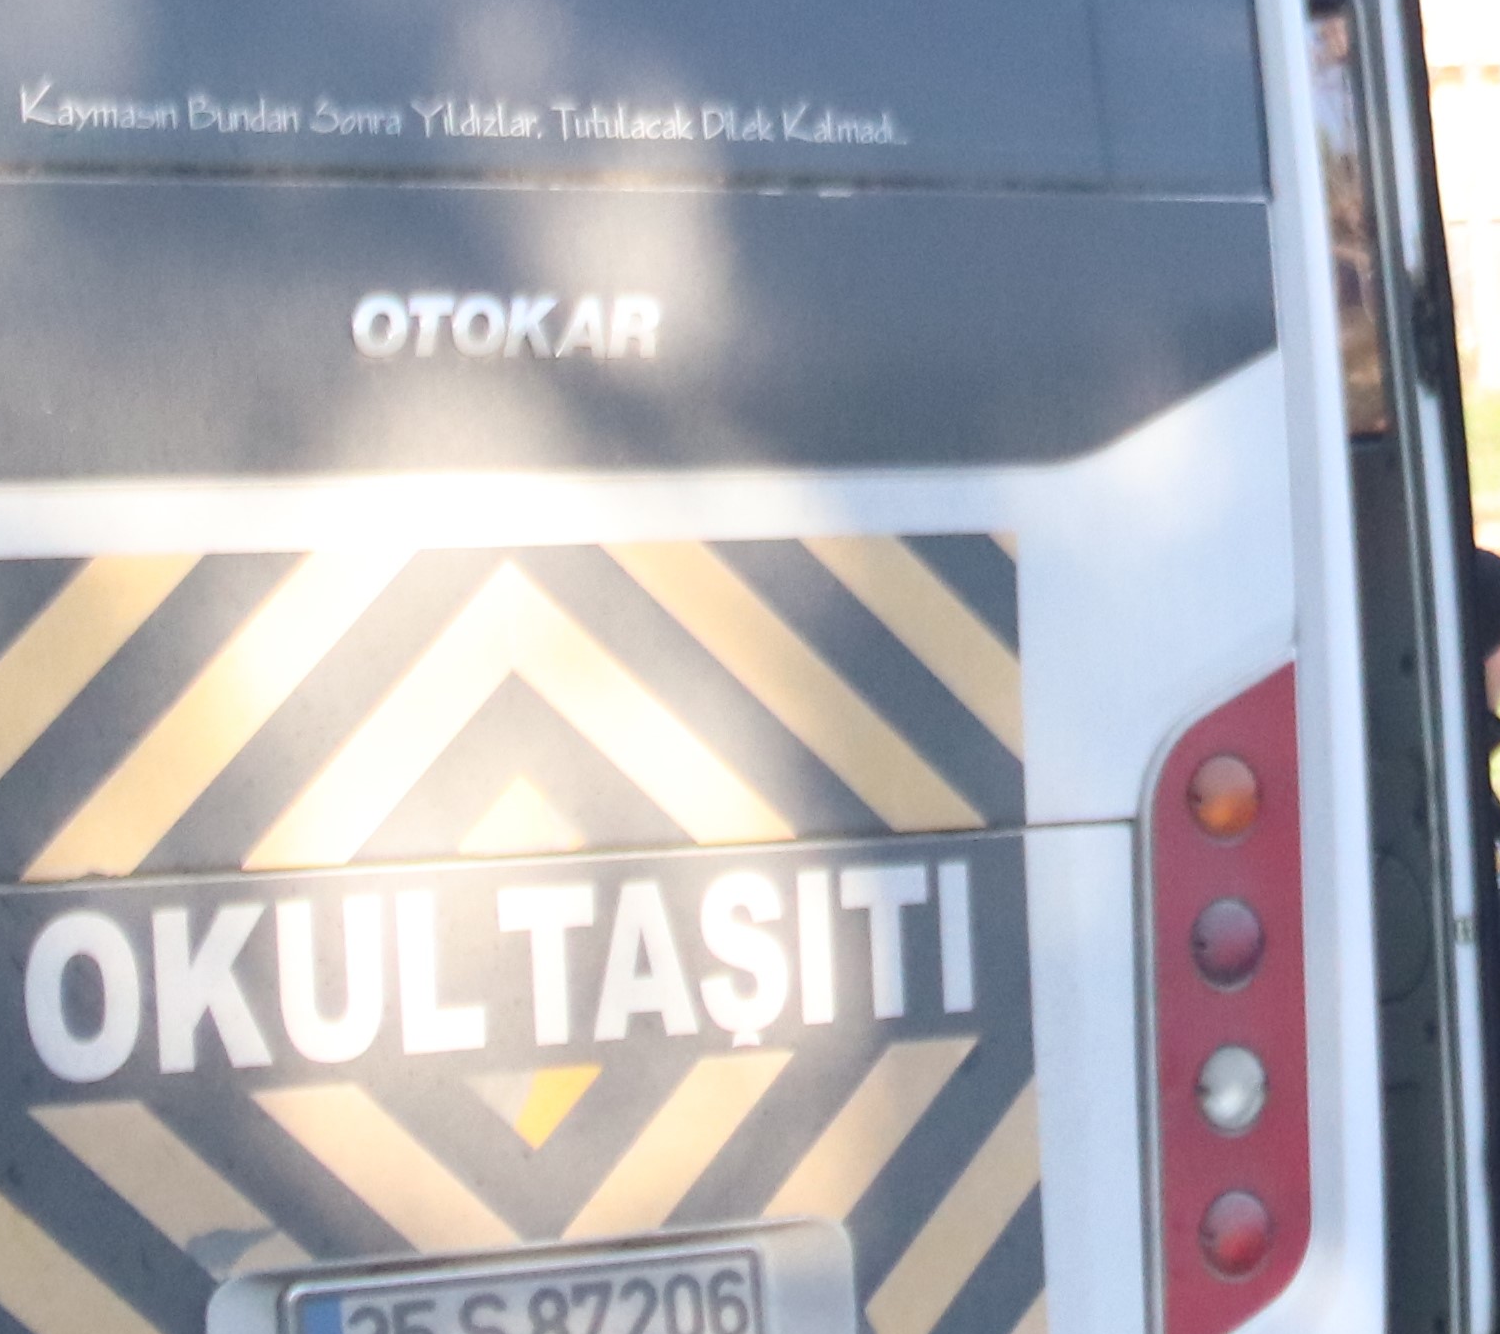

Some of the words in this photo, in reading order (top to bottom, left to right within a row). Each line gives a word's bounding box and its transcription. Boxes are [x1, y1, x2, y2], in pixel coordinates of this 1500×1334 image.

[188, 92, 300, 134] Bundan
[310, 94, 402, 136] Sonra
[552, 100, 694, 142] Tutulacak
[352, 291, 661, 359] OTOKAR
[24, 887, 488, 1085] OKUL
[498, 859, 976, 1049] TAŞITI
